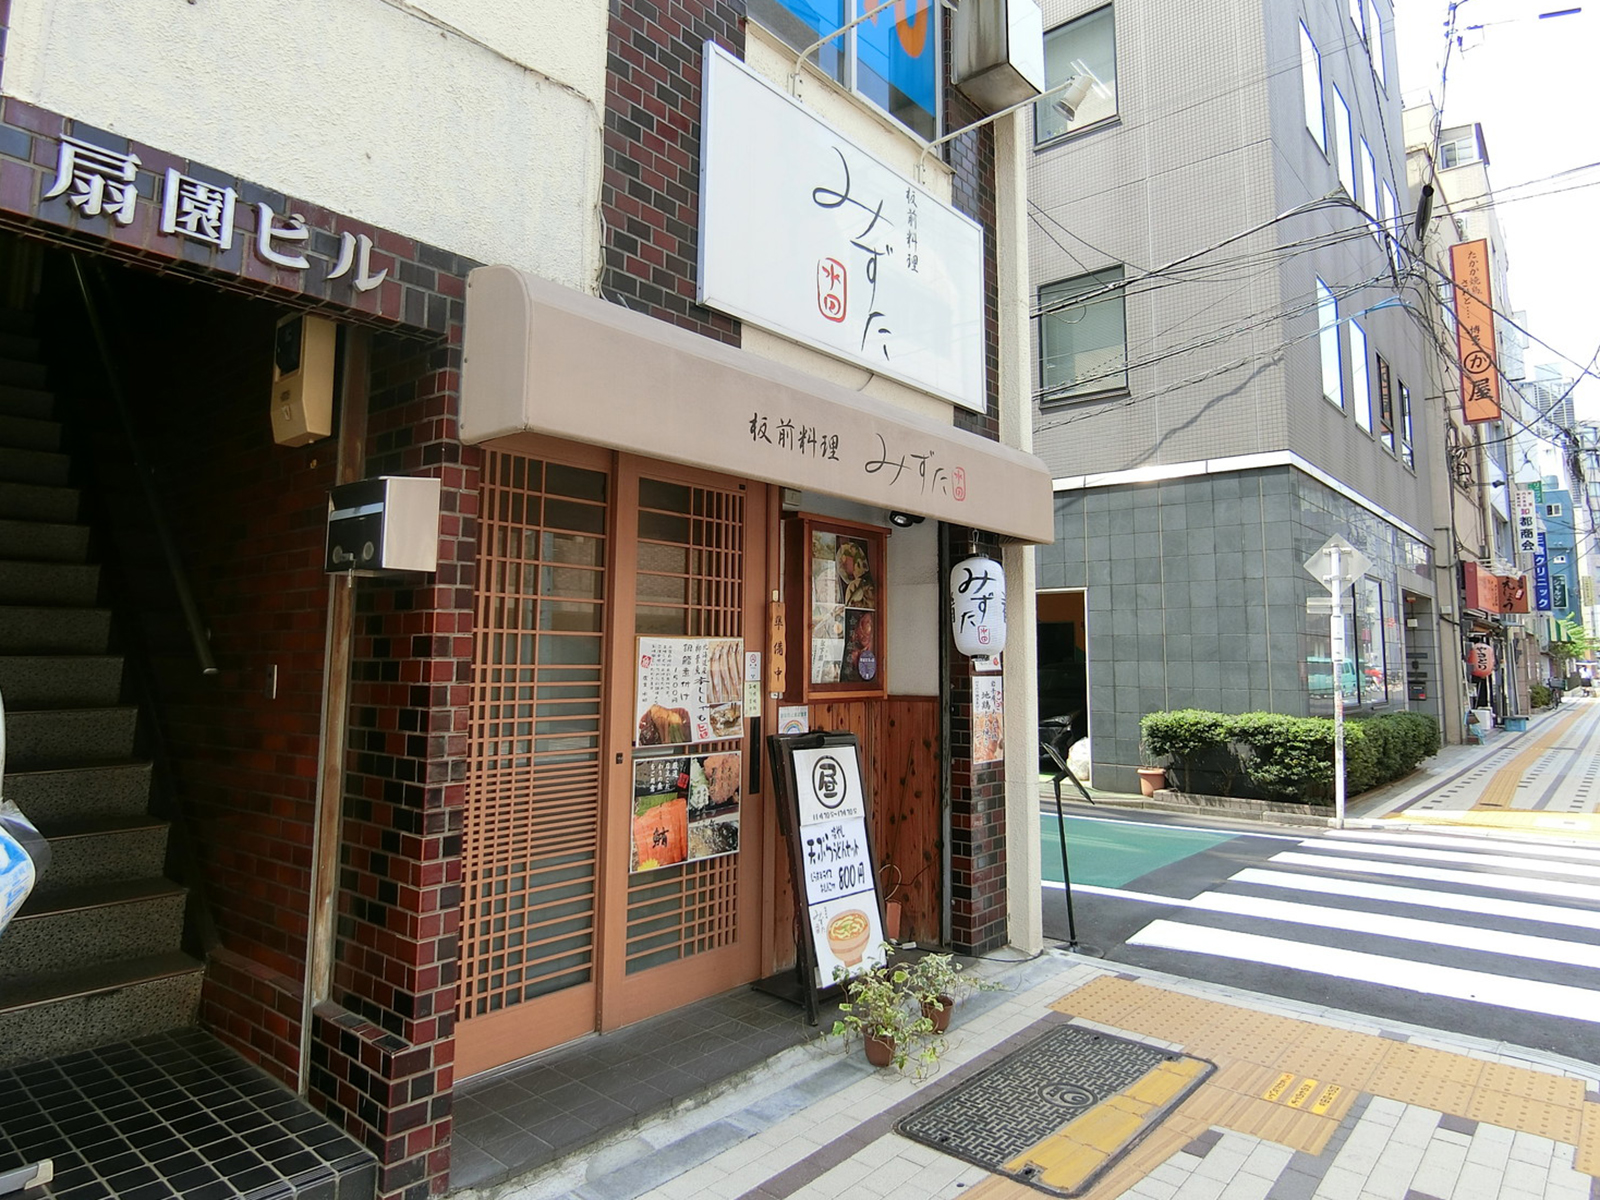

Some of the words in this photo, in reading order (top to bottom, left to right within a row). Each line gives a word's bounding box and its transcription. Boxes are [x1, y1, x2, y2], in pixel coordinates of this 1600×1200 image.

[44, 132, 388, 293] 扇園ビル
[906, 186, 919, 274] 板前料理
[812, 146, 895, 362] みずた
[749, 412, 840, 462] 板前料理
[865, 433, 948, 496] みずた
[958, 567, 996, 634] みずた
[818, 762, 839, 799] 昼
